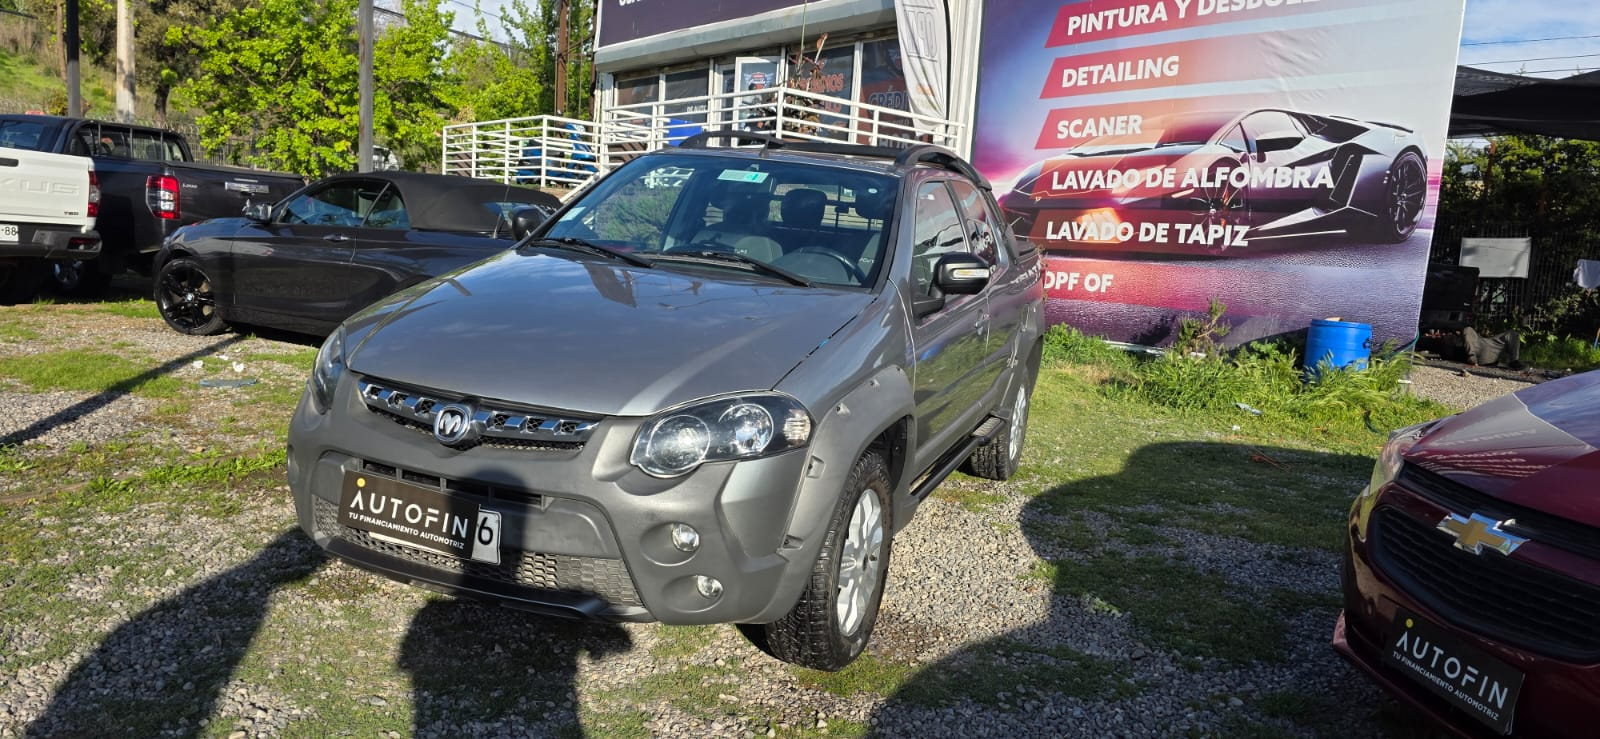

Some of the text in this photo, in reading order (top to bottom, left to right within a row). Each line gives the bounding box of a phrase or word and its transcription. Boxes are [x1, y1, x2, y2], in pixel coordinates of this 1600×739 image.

[1067, 2, 1168, 36] PINTURA
[1175, 0, 1191, 18] Y
[1062, 56, 1179, 88] DETAILING
[1057, 115, 1143, 139] SCANER
[1052, 166, 1334, 190] LAVADO DE ALFOMBRA
[1046, 222, 1250, 247] LAVADO DE TAPIZ
[1043, 270, 1080, 291] DPF
[1084, 273, 1114, 293] OF
[350, 489, 469, 539] AUTOFIN
[349, 512, 465, 550] TU FINANCIAMIENTO AUTOMOTRIZ
[478, 516, 494, 545] 6
[1392, 650, 1499, 721] TU FINANCIAMIENTO AUTOMOTRIZ
[1395, 631, 1508, 709] AUTOFIN
